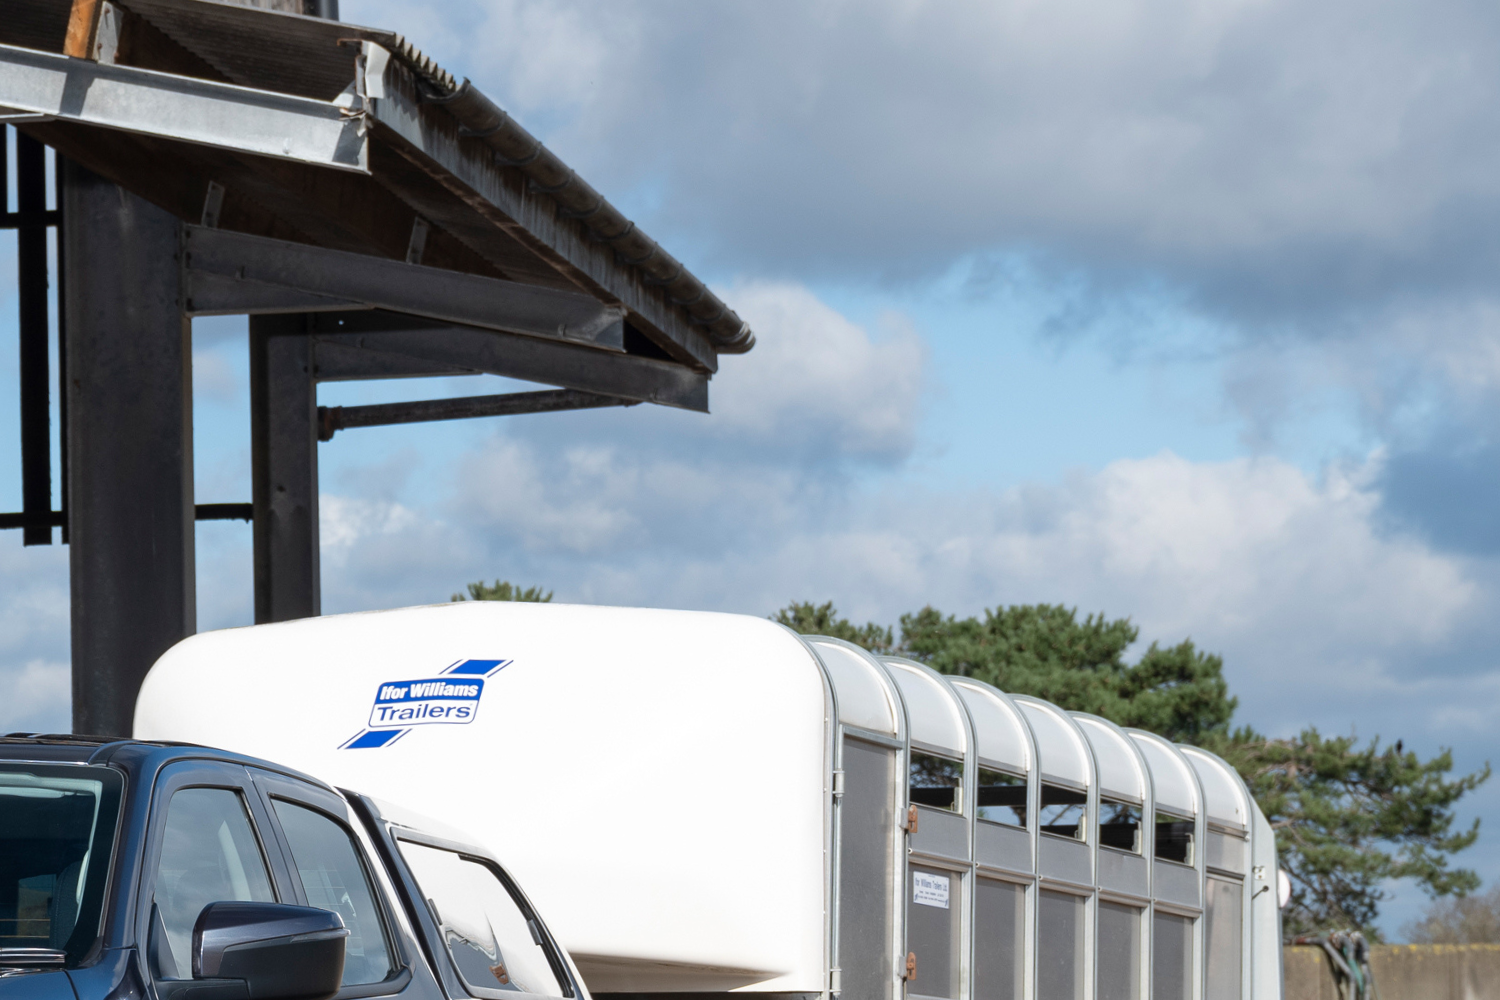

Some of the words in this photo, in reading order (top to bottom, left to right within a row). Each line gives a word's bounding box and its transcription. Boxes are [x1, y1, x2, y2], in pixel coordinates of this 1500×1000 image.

[380, 685, 408, 701] Ifor
[410, 681, 479, 699] Williams
[376, 703, 471, 722] Trailers
